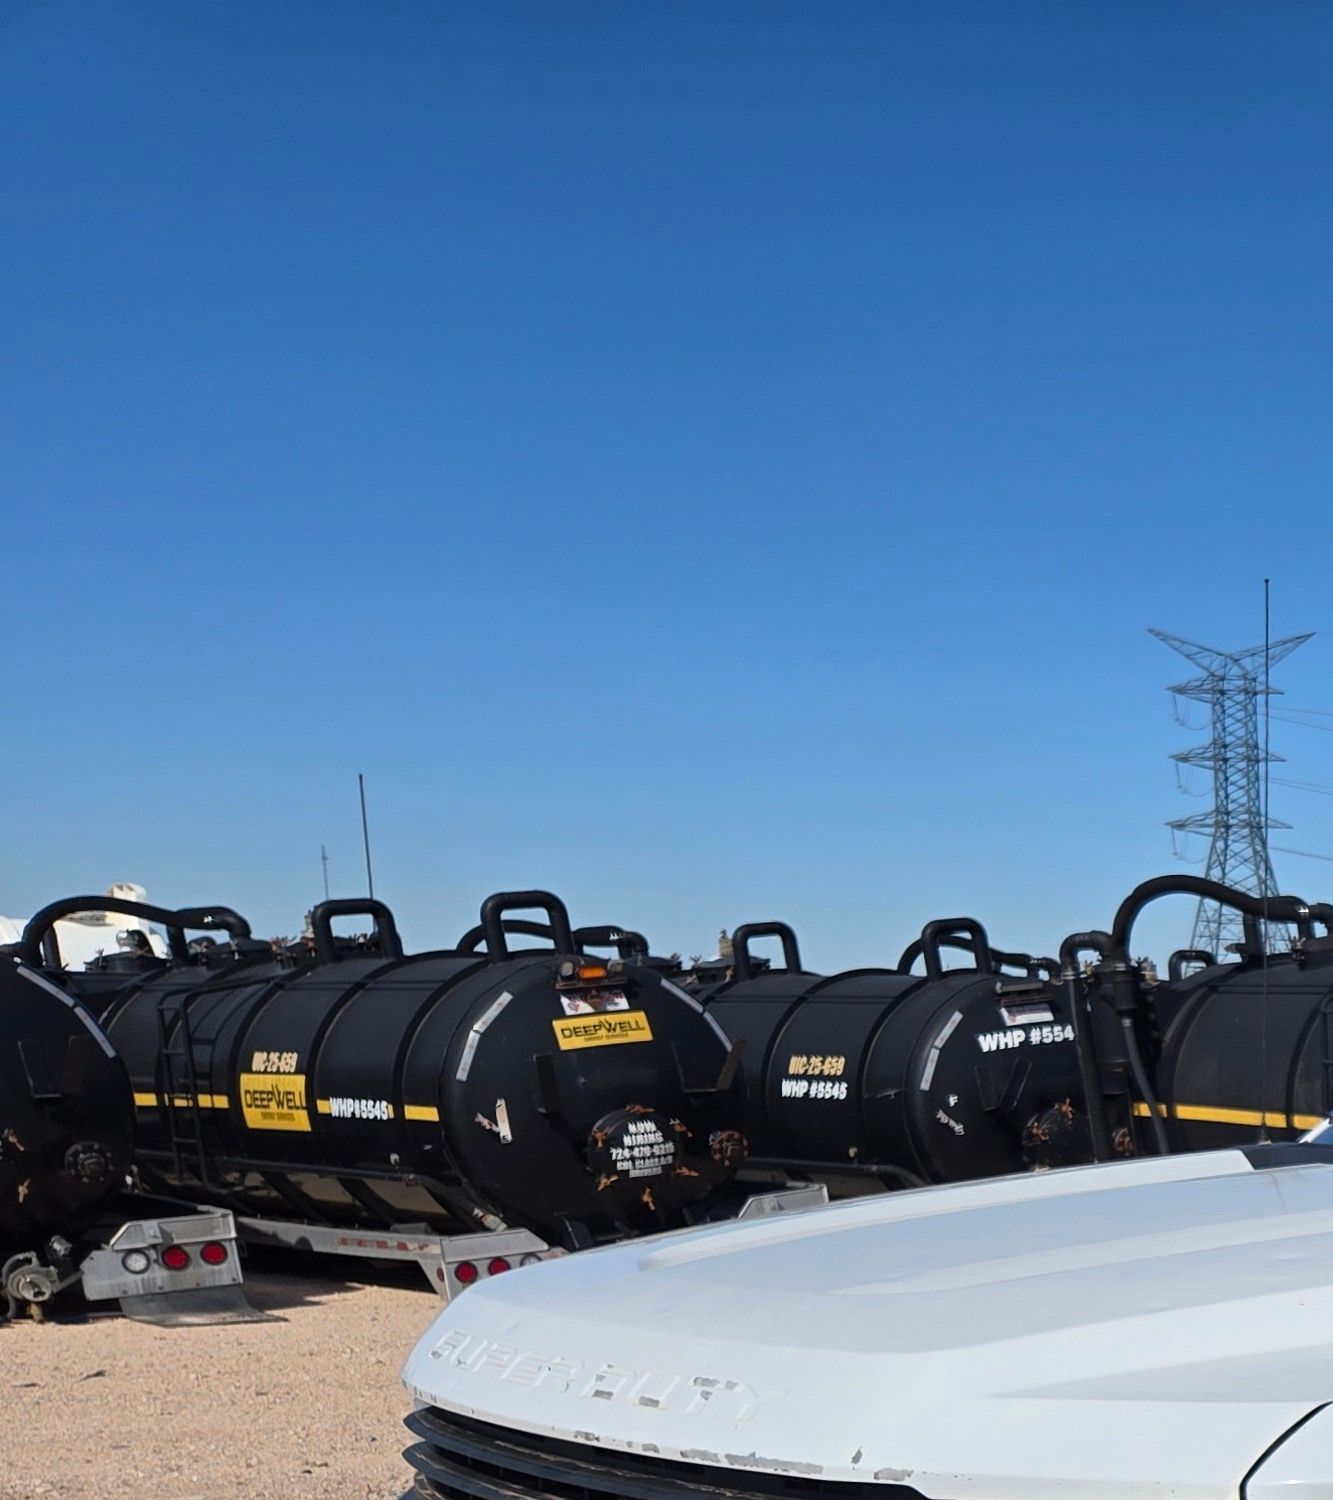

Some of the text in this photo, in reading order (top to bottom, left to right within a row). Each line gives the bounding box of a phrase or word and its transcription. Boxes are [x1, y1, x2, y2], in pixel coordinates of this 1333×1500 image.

[977, 1029, 1026, 1053] WHP
[781, 1078, 809, 1098] WHP
[429, 1330, 584, 1393] SUPER
